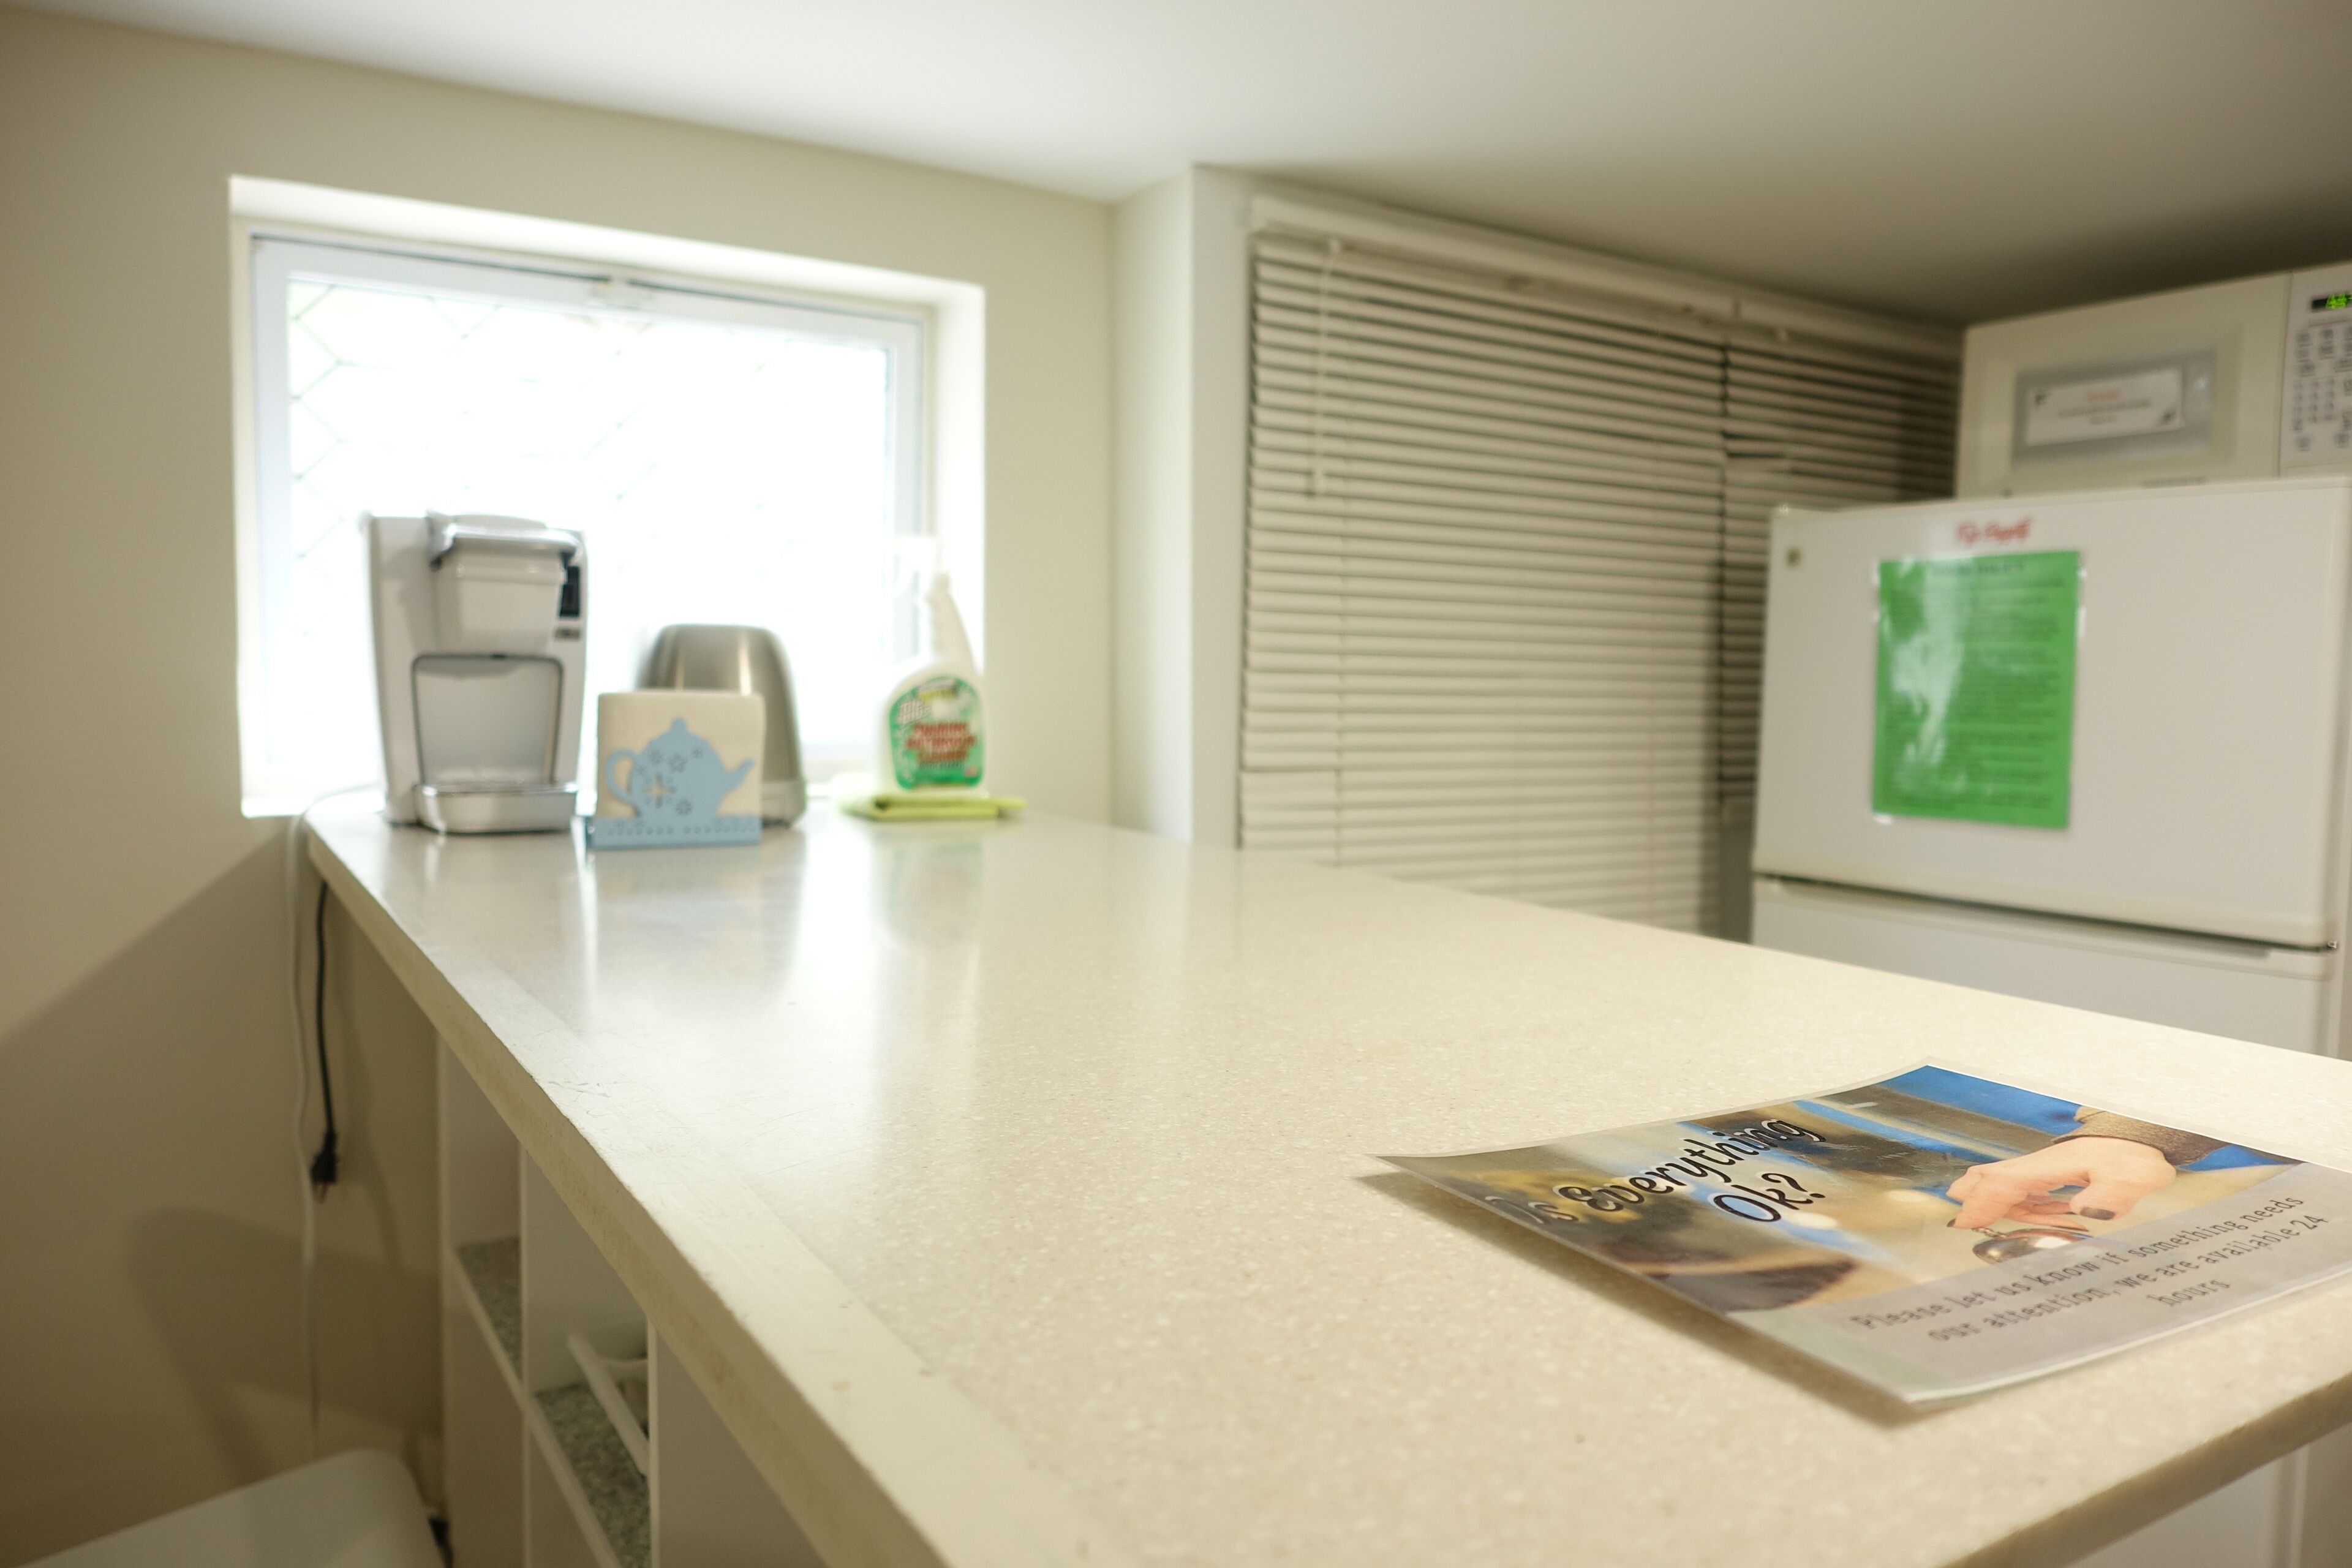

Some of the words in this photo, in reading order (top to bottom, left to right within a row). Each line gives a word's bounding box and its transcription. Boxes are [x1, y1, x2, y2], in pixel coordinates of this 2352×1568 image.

[1553, 1119, 1826, 1212] Everything
[1713, 1172, 1826, 1223] Ok?
[1849, 1303, 1953, 1329] Please
[1943, 1291, 1997, 1309] let
[1994, 1281, 2034, 1296] us
[2022, 1259, 2101, 1287] know
[2097, 1251, 2129, 1266] if
[2128, 1219, 2250, 1258] something
[2239, 1196, 2305, 1223] needs
[1928, 1322, 1981, 1341] our
[1983, 1286, 2122, 1329] attention,
[2114, 1271, 2158, 1289] we
[2155, 1259, 2200, 1278] are
[2197, 1227, 2301, 1265] available
[2289, 1213, 2329, 1231] 24
[2146, 1278, 2231, 1308] hours
